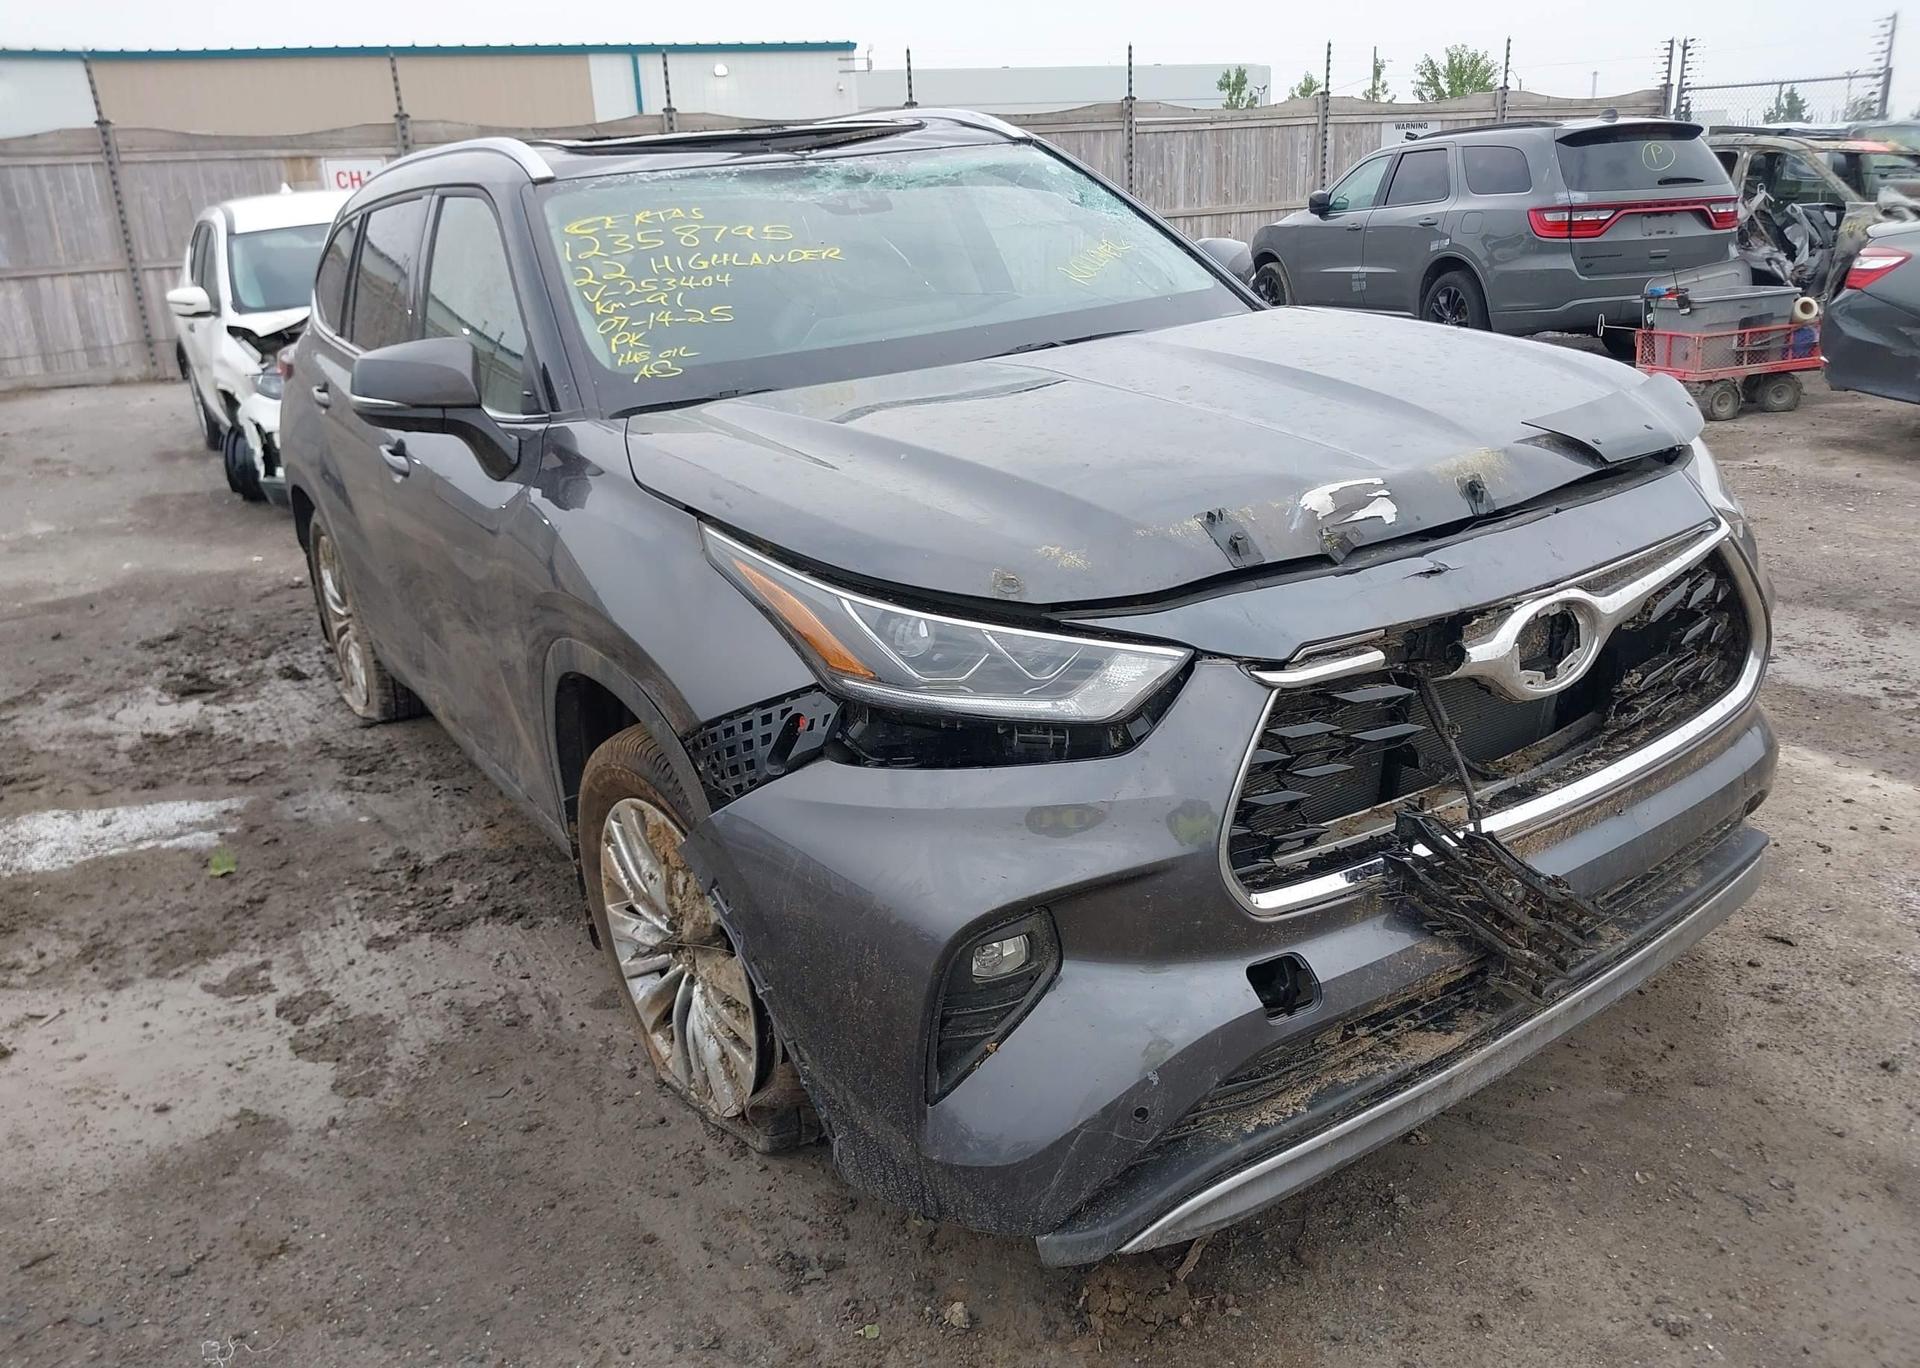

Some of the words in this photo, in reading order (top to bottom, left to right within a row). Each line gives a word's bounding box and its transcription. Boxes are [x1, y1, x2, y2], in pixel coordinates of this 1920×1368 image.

[1394, 122, 1428, 130] WARNING
[574, 261, 633, 287] 22
[650, 248, 847, 275] HIGHLANDER
[597, 306, 734, 334] 07-14-25
